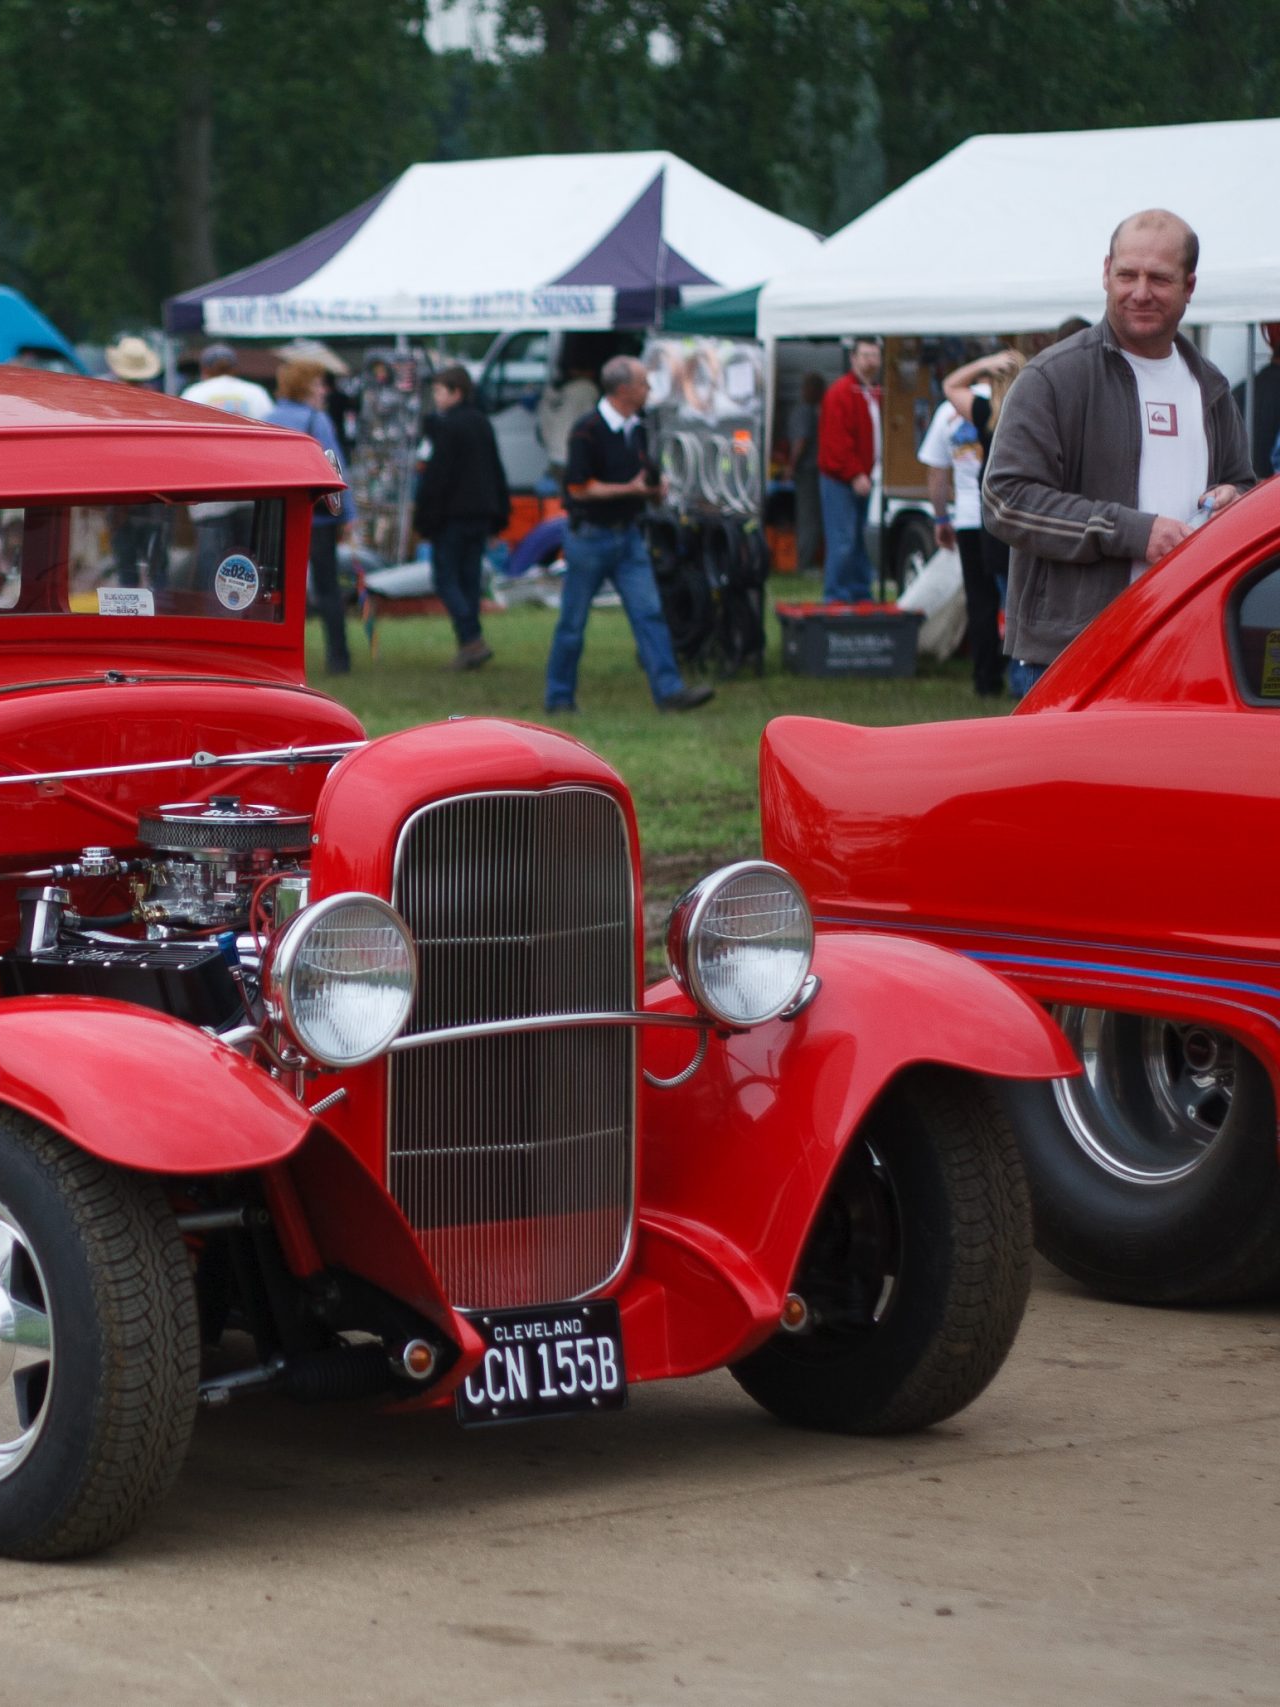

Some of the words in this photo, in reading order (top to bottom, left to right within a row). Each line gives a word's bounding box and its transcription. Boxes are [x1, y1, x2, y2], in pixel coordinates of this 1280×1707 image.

[231, 564, 245, 580] 02
[494, 1319, 582, 1341] CLEVELAND
[537, 1336, 618, 1397] 155B
